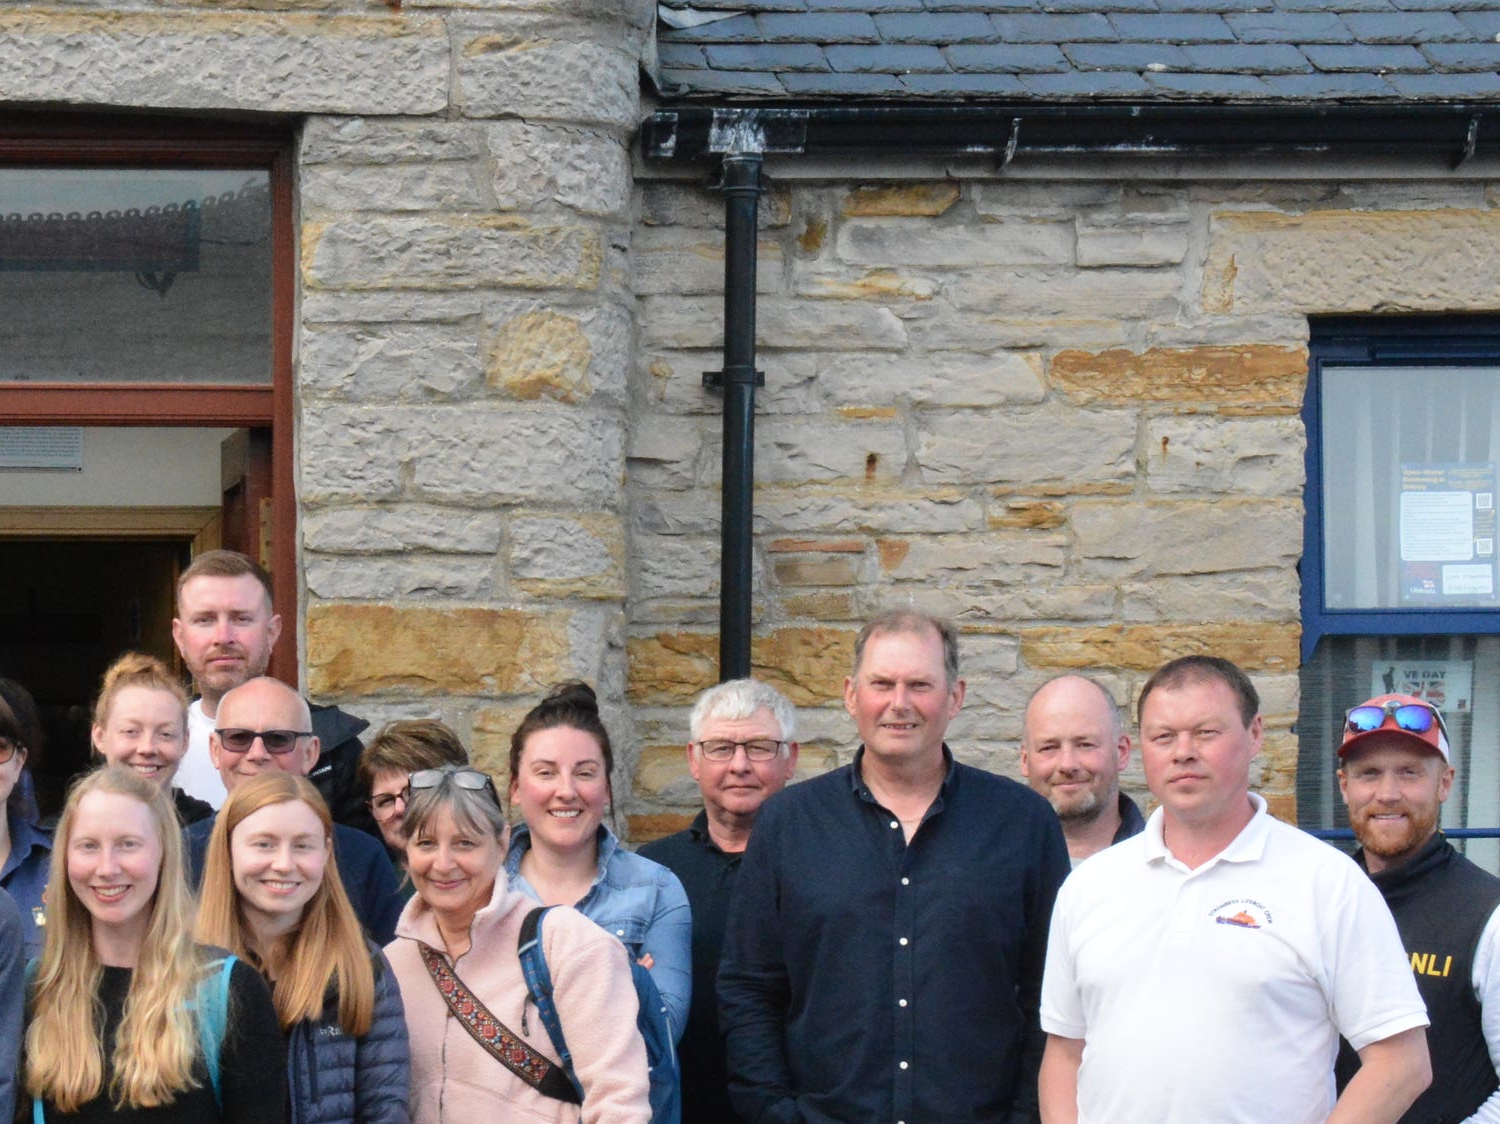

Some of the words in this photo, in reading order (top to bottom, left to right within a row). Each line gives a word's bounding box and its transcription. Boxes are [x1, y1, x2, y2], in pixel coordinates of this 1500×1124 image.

[1404, 670, 1420, 680] VE
[1422, 670, 1446, 680] DAY
[1409, 952, 1453, 977] NLI
